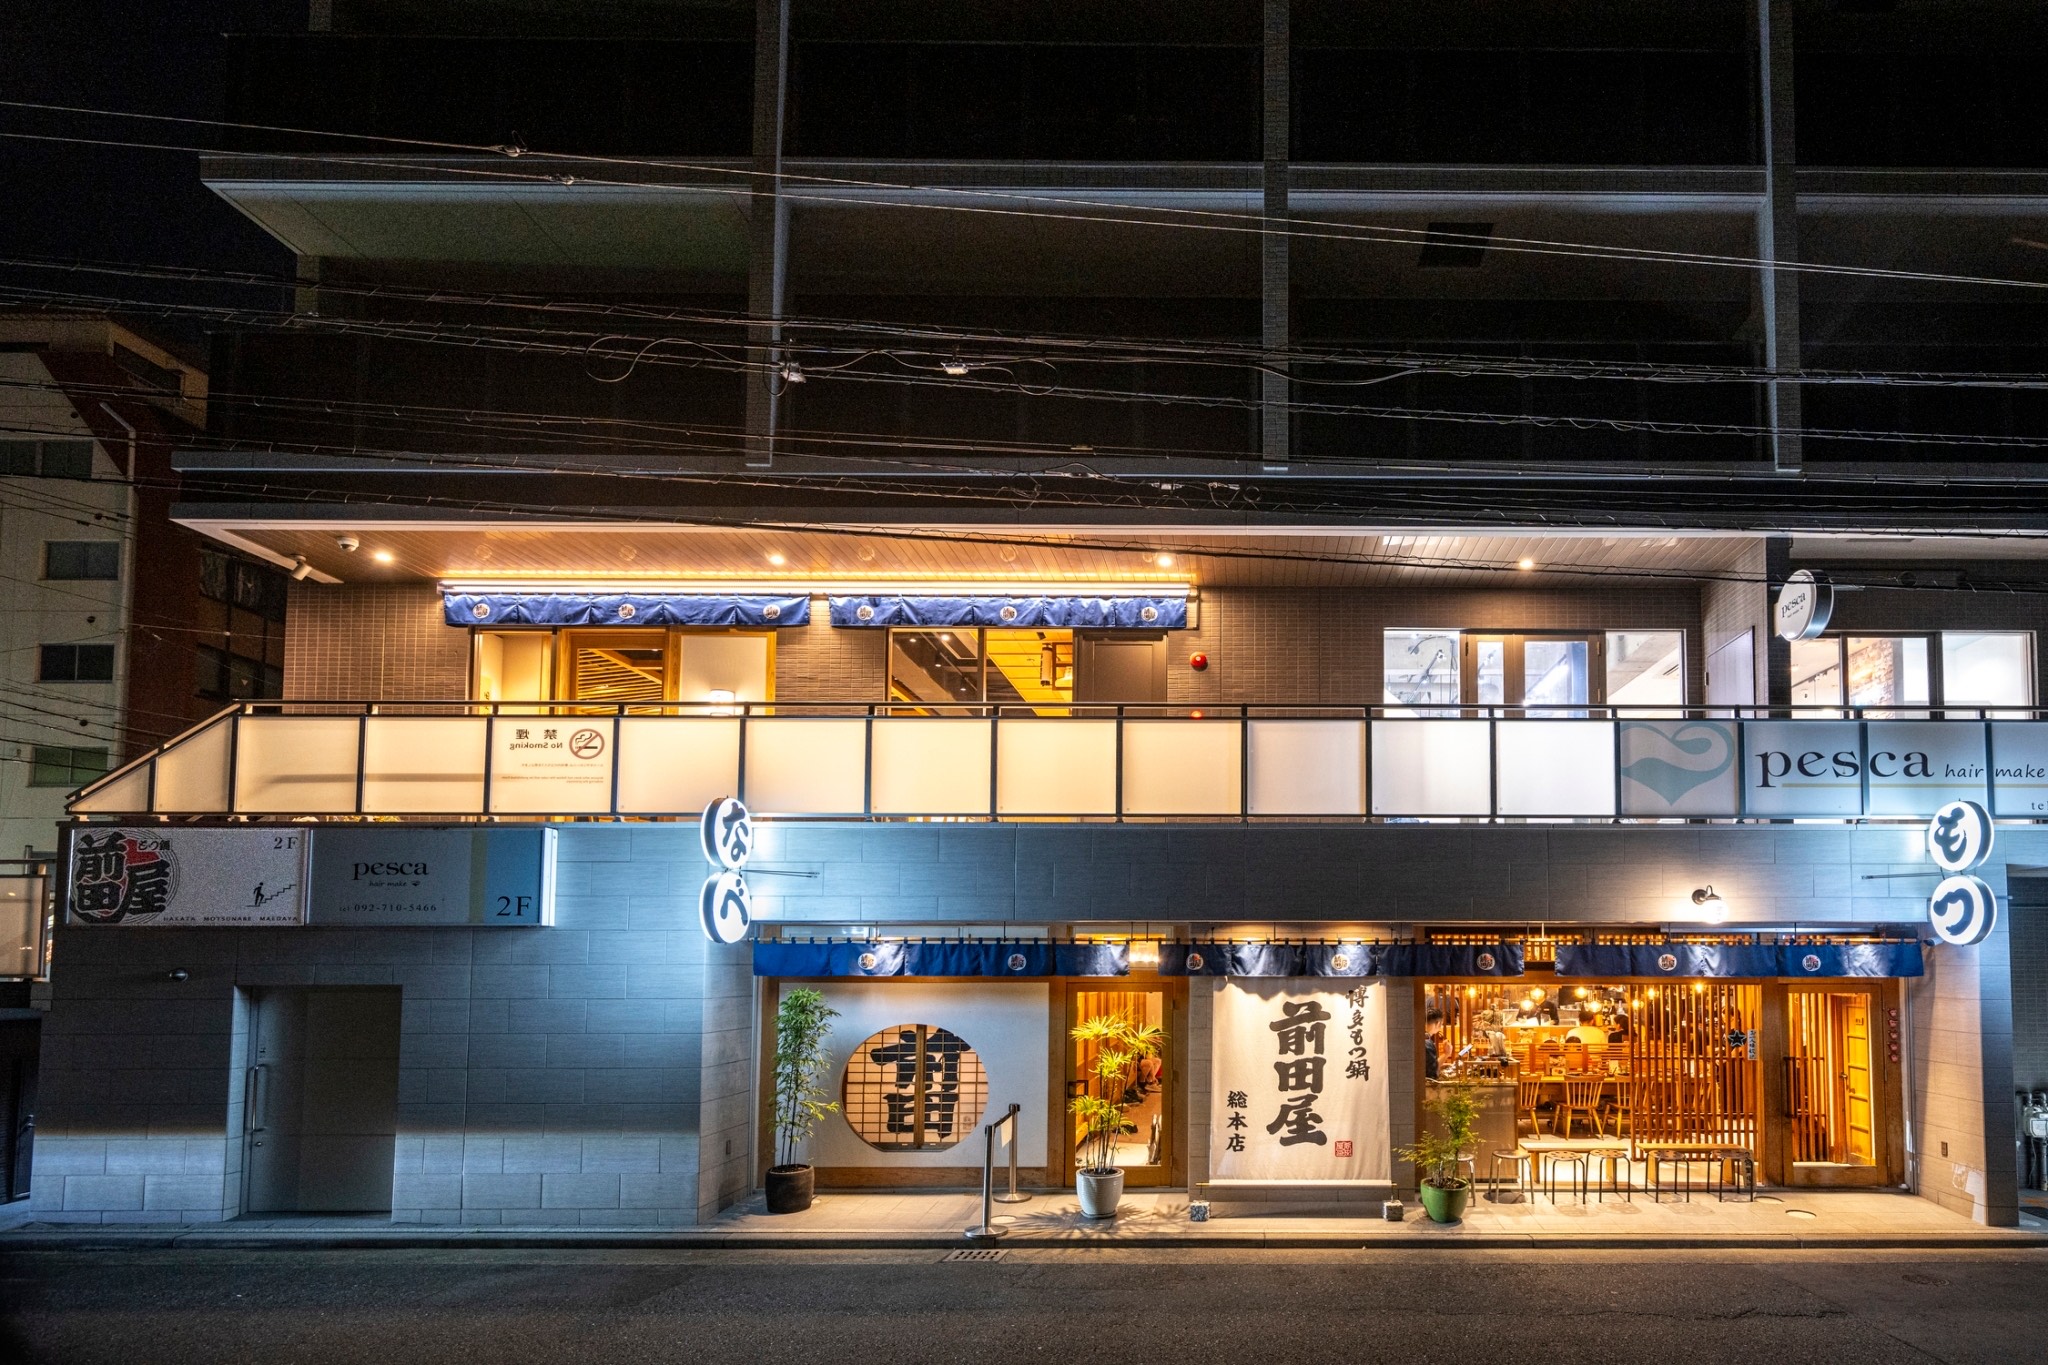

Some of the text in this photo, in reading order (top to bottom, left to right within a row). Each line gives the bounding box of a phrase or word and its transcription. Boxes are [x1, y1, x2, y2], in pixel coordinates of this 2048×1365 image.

[1755, 750, 2046, 788] pesca hair make
[69, 831, 171, 924] 前田屋
[352, 861, 429, 881] pesca
[720, 802, 749, 926] なべ
[1934, 807, 1974, 936] もつ
[354, 903, 437, 912] 092-710-5466
[496, 895, 532, 917] 2F
[1345, 985, 1370, 1081] 博多もつ鍋
[1266, 1000, 1331, 1146] 前田屋
[1225, 1091, 1248, 1152] 総本店
